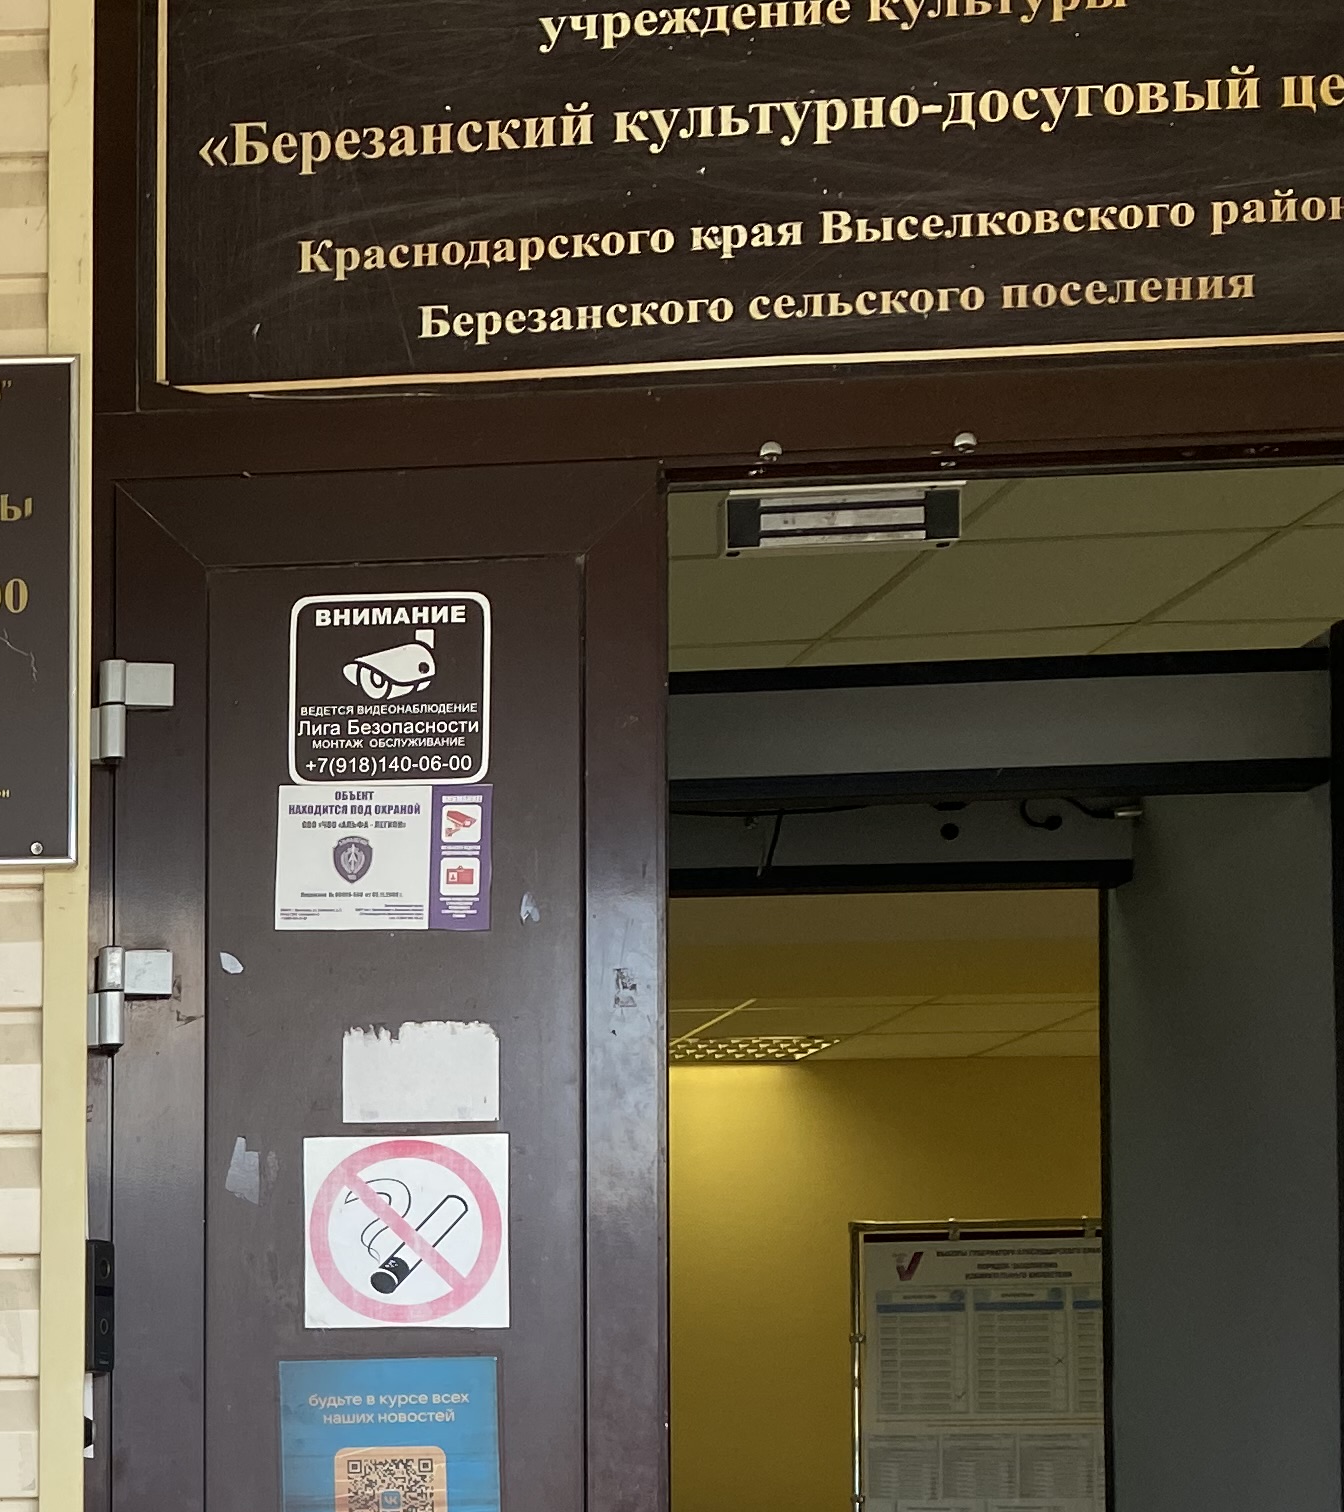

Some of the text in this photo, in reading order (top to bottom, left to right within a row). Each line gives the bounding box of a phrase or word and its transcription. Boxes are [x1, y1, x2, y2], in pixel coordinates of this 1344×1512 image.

[539, 0, 852, 53] учреждение
[198, 99, 594, 173] «Березанский
[613, 64, 1261, 151] культурно-досуговый
[297, 222, 675, 278] Краснодарского
[690, 218, 803, 261] края
[818, 194, 1196, 249] Выселковского
[417, 268, 1257, 344] Березанского сельского поселения
[315, 605, 466, 627] ВНИМАНИЕ
[301, 703, 478, 716] ВЕДЕТСЯ ВИДЕОНАБЛЮДЕНИЕ
[297, 719, 479, 738] Лига Безопасности
[312, 737, 466, 749] МОНТАЖ ОБСЛУЖИВАНИЕ
[305, 755, 472, 776] +7(918)140-06-00
[288, 802, 421, 816] НАХОДИТСЯ ПОД ОХРАНОЙ
[308, 1392, 470, 1409] будьте в курсе всех
[323, 1409, 455, 1424] наших новостей
